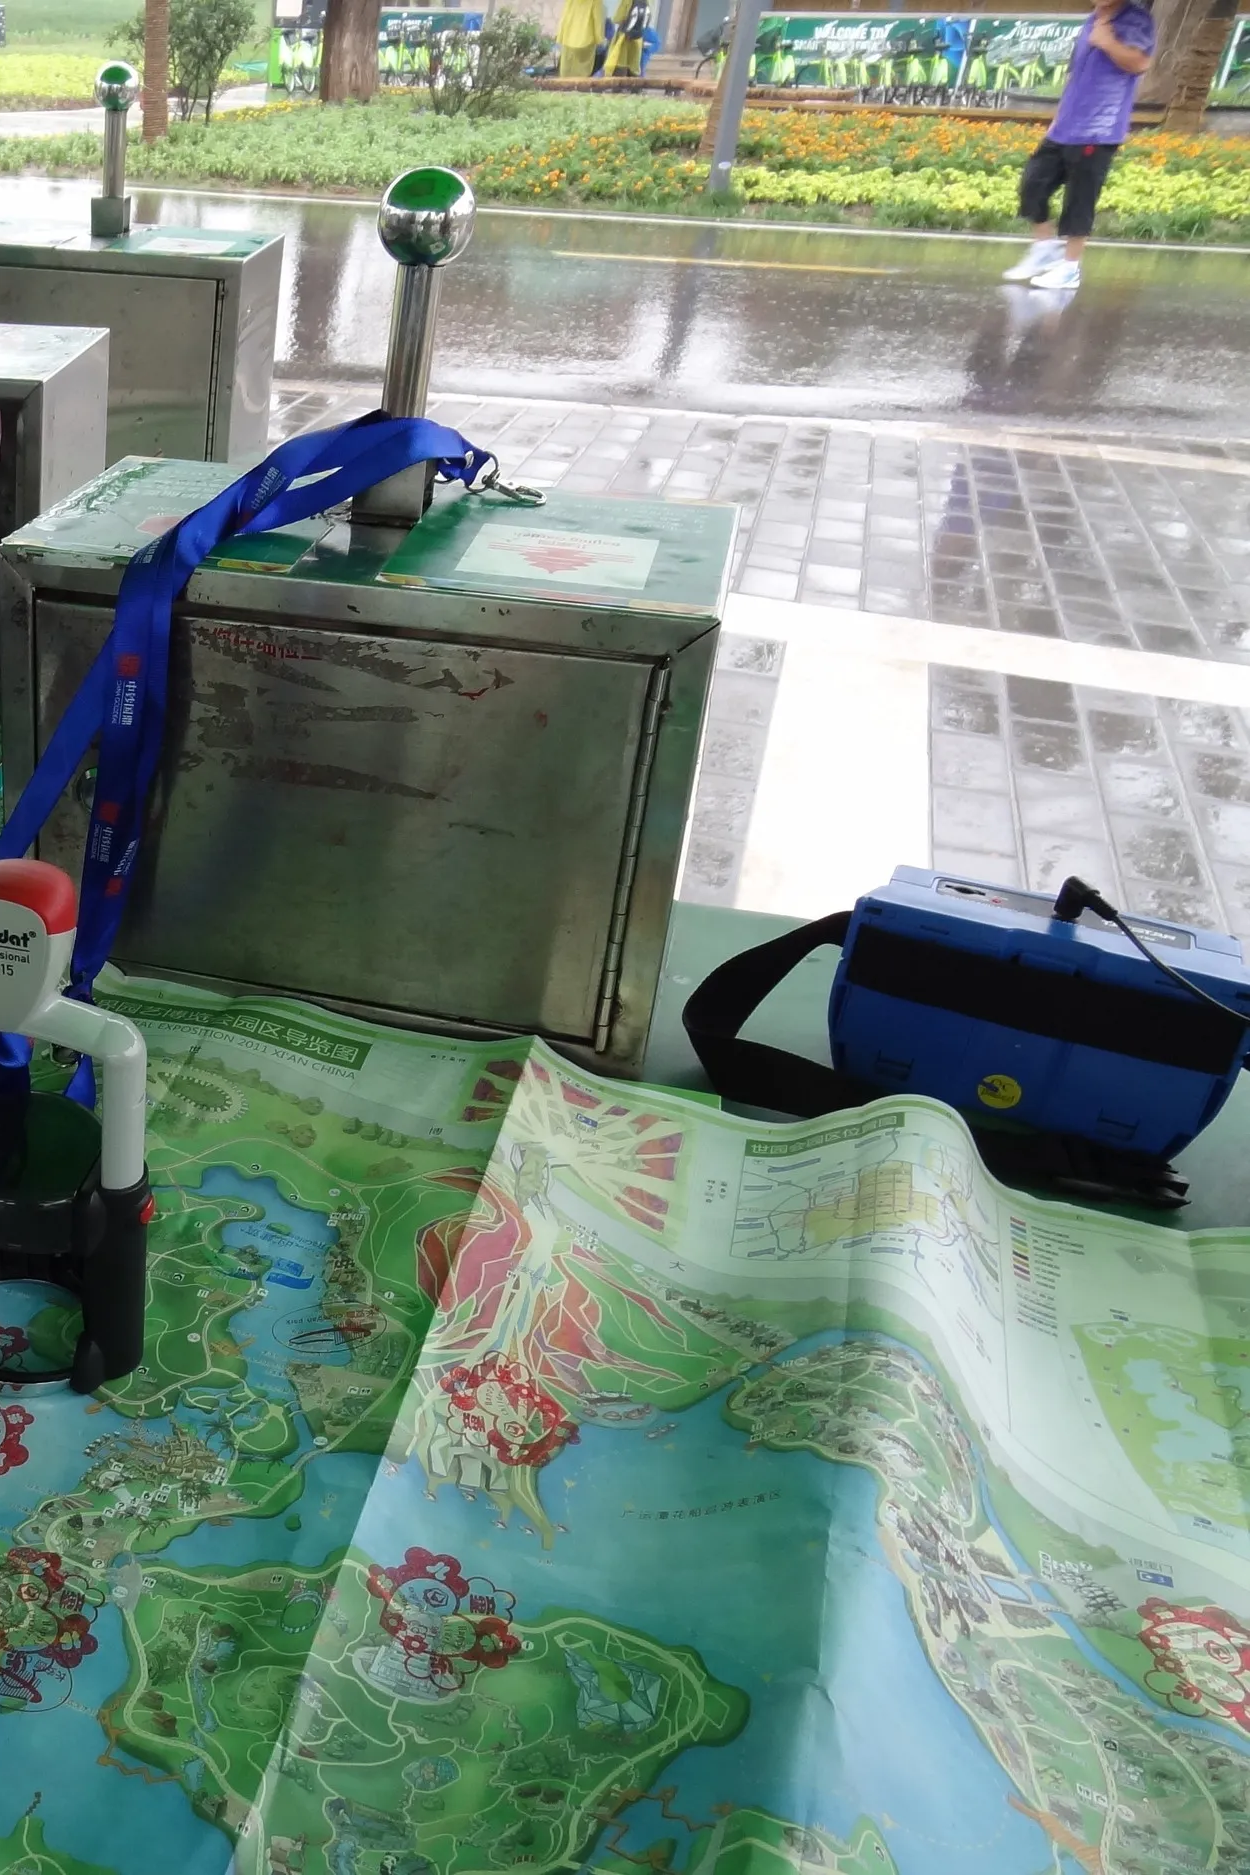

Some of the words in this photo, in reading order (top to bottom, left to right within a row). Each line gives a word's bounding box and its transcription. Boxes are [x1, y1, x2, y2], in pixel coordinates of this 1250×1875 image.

[157, 1022, 235, 1043] EXPOSITION
[237, 1039, 268, 1055] 2011
[272, 1048, 309, 1067] XI'AN
[312, 1060, 356, 1080] CHINA
